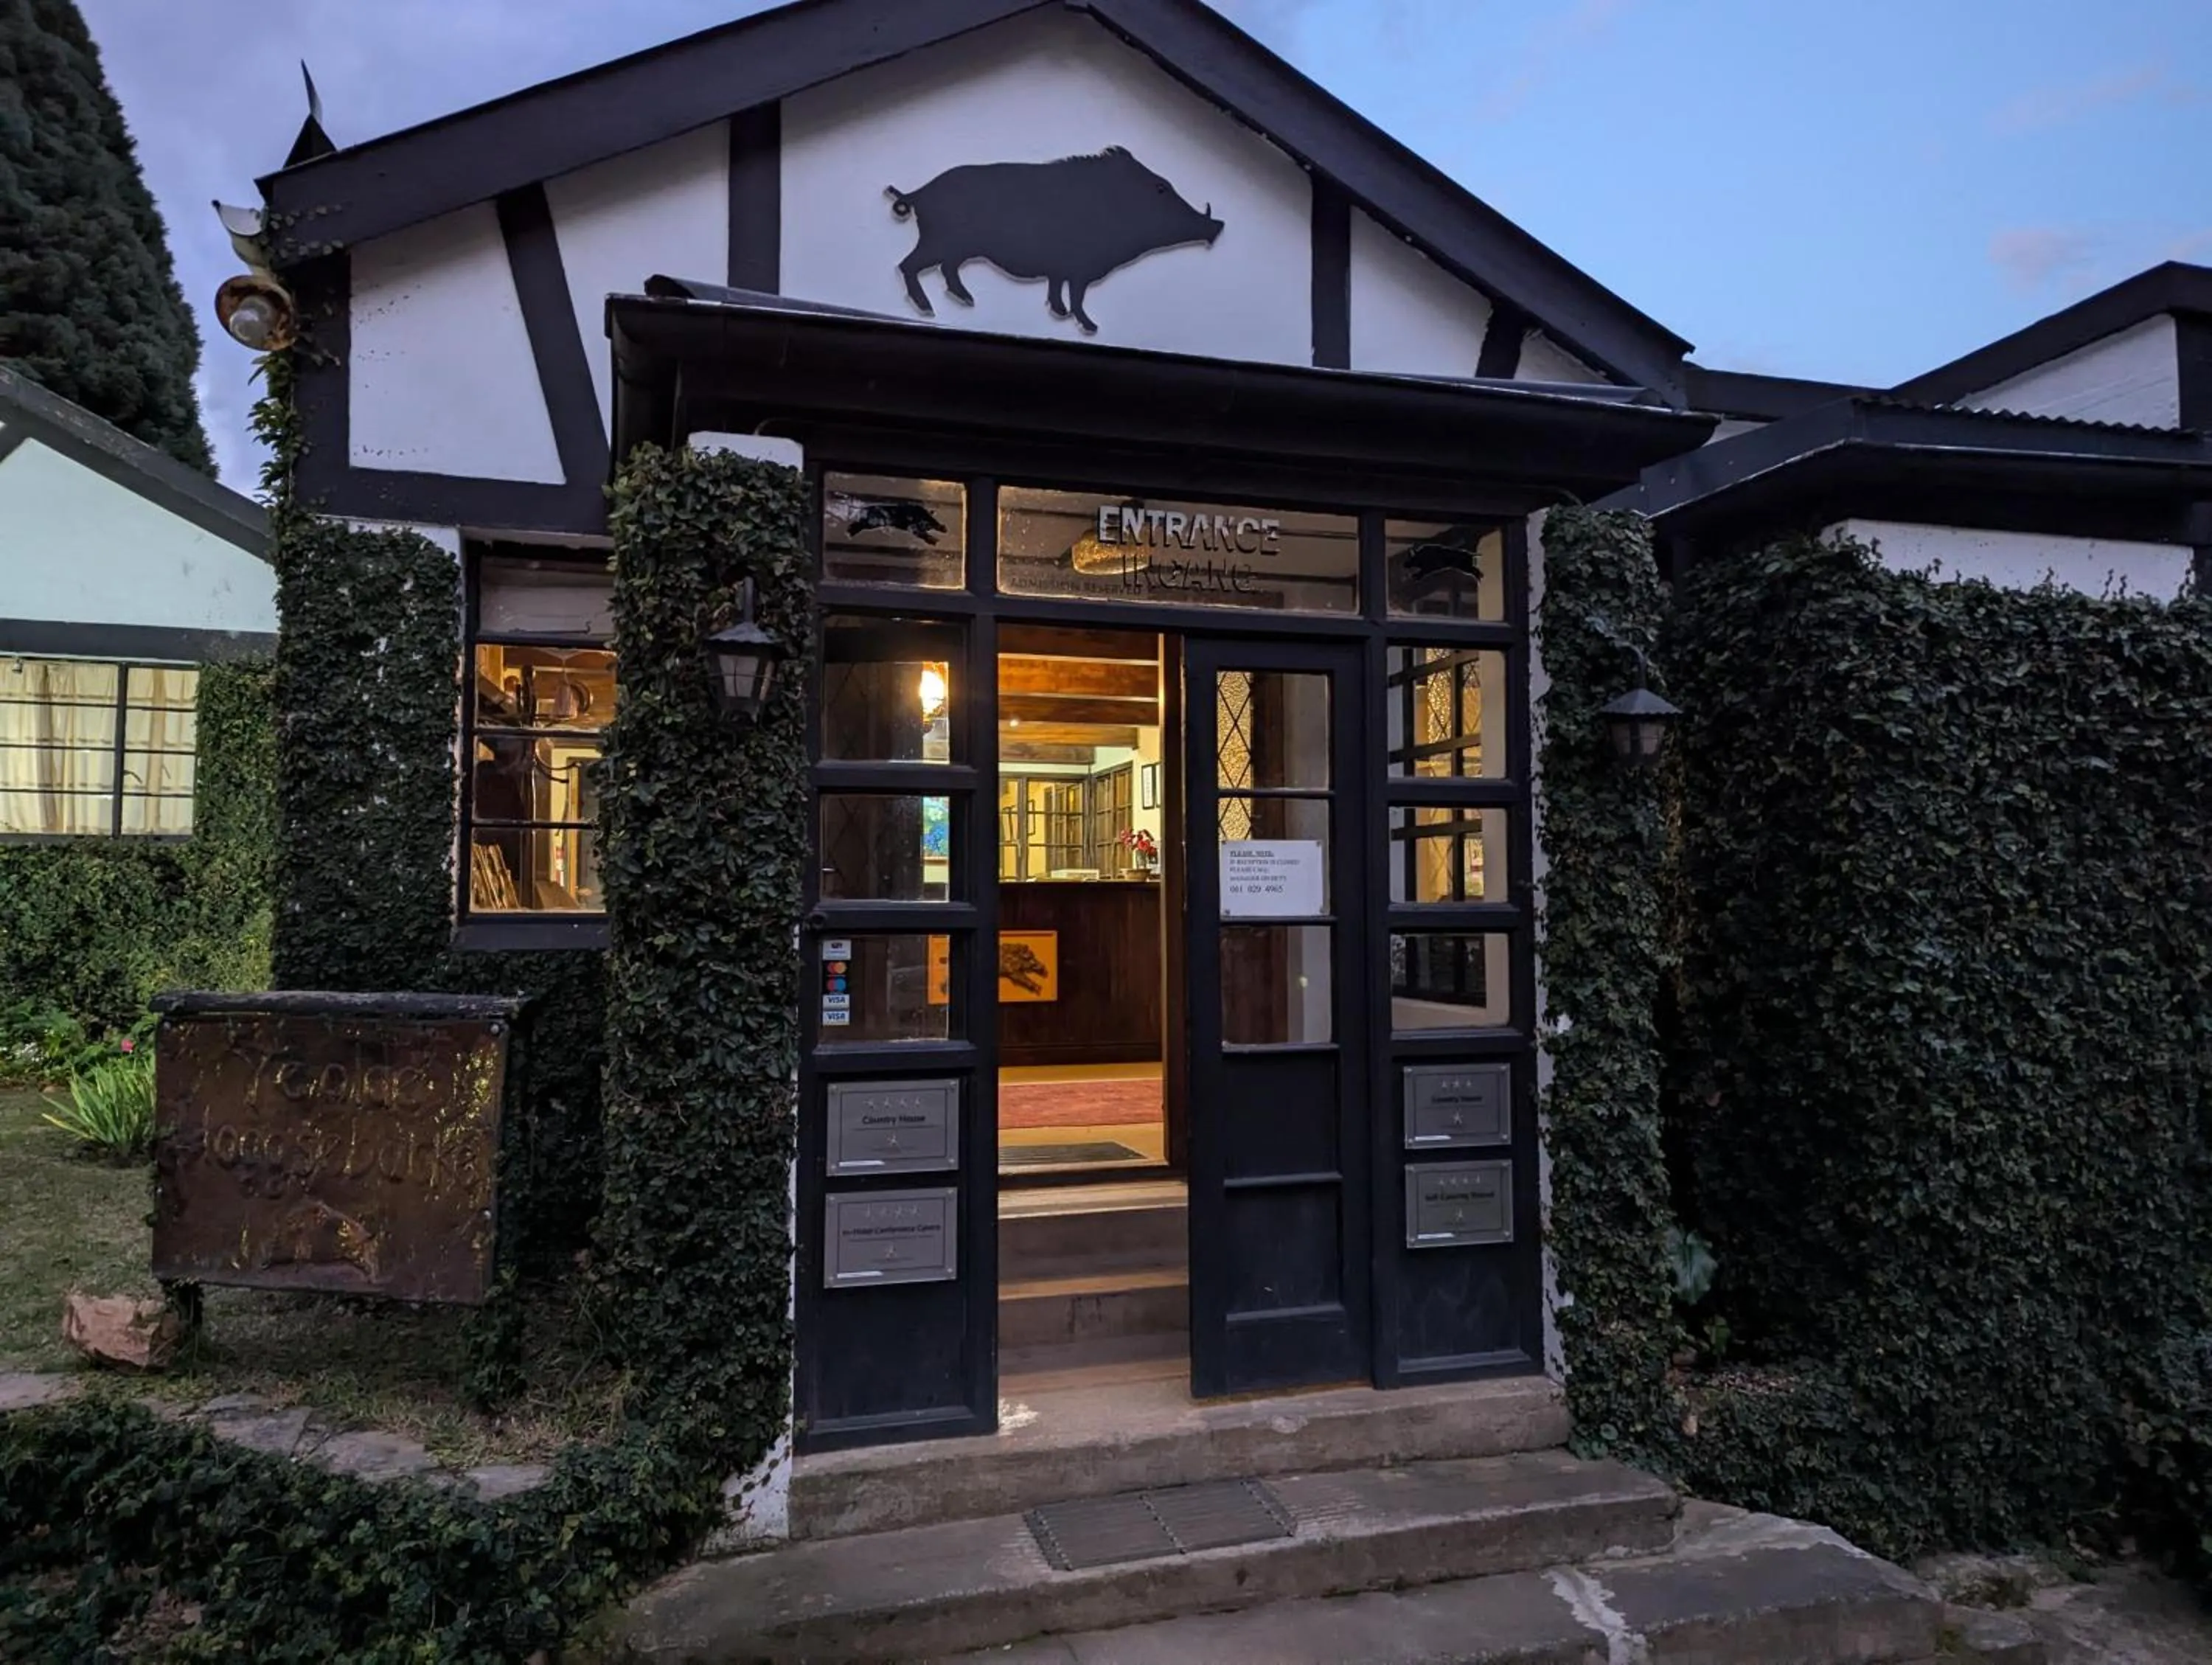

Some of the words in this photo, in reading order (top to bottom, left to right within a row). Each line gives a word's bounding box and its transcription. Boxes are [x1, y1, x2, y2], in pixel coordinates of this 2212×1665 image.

[1096, 504, 1281, 557] ENTRANCE
[862, 1115, 897, 1125] Country
[899, 1114, 926, 1122] House
